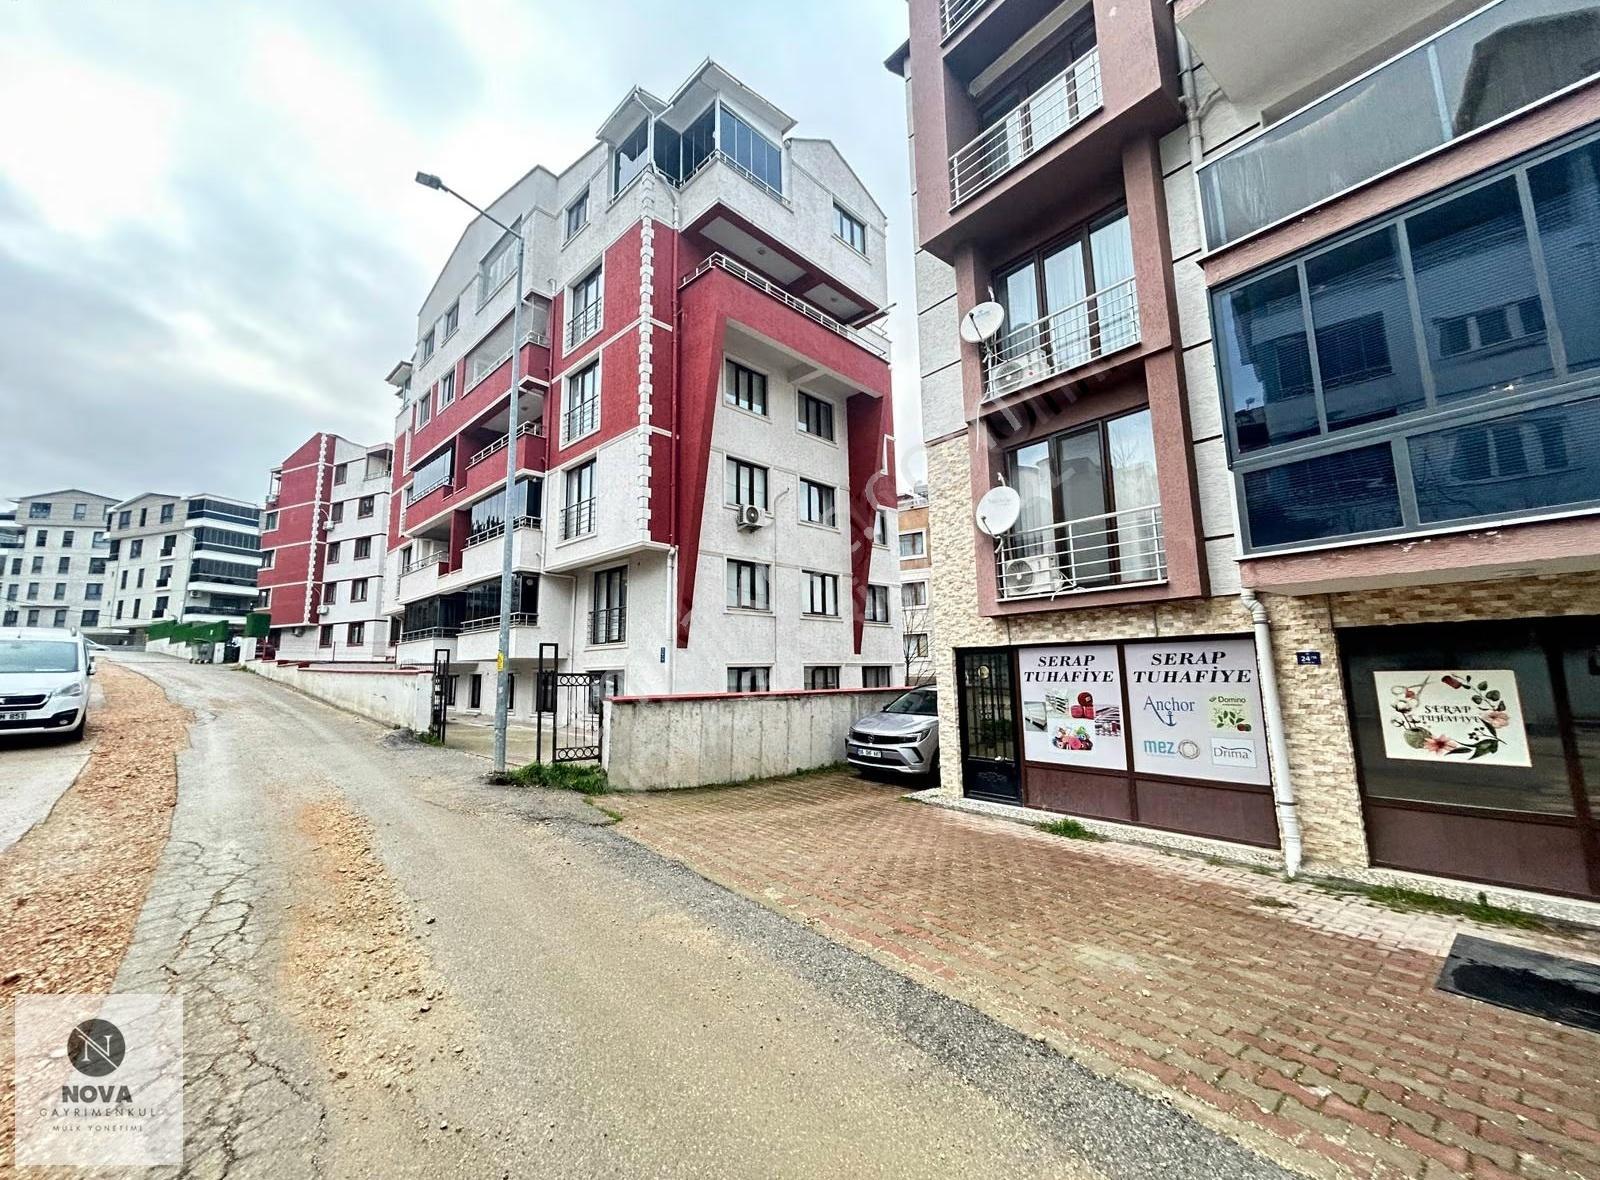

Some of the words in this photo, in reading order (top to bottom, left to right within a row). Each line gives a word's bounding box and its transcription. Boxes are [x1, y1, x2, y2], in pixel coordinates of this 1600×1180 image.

[1038, 655, 1095, 667] SERAP
[1150, 651, 1226, 666] SERAP
[1024, 668, 1114, 683] TUHAFİYE
[1133, 666, 1252, 683] TUHAFİYE
[1143, 695, 1195, 722] Anchor
[1424, 705, 1471, 714] SERAP
[1143, 740, 1175, 754] mez
[1213, 746, 1252, 759] Drima
